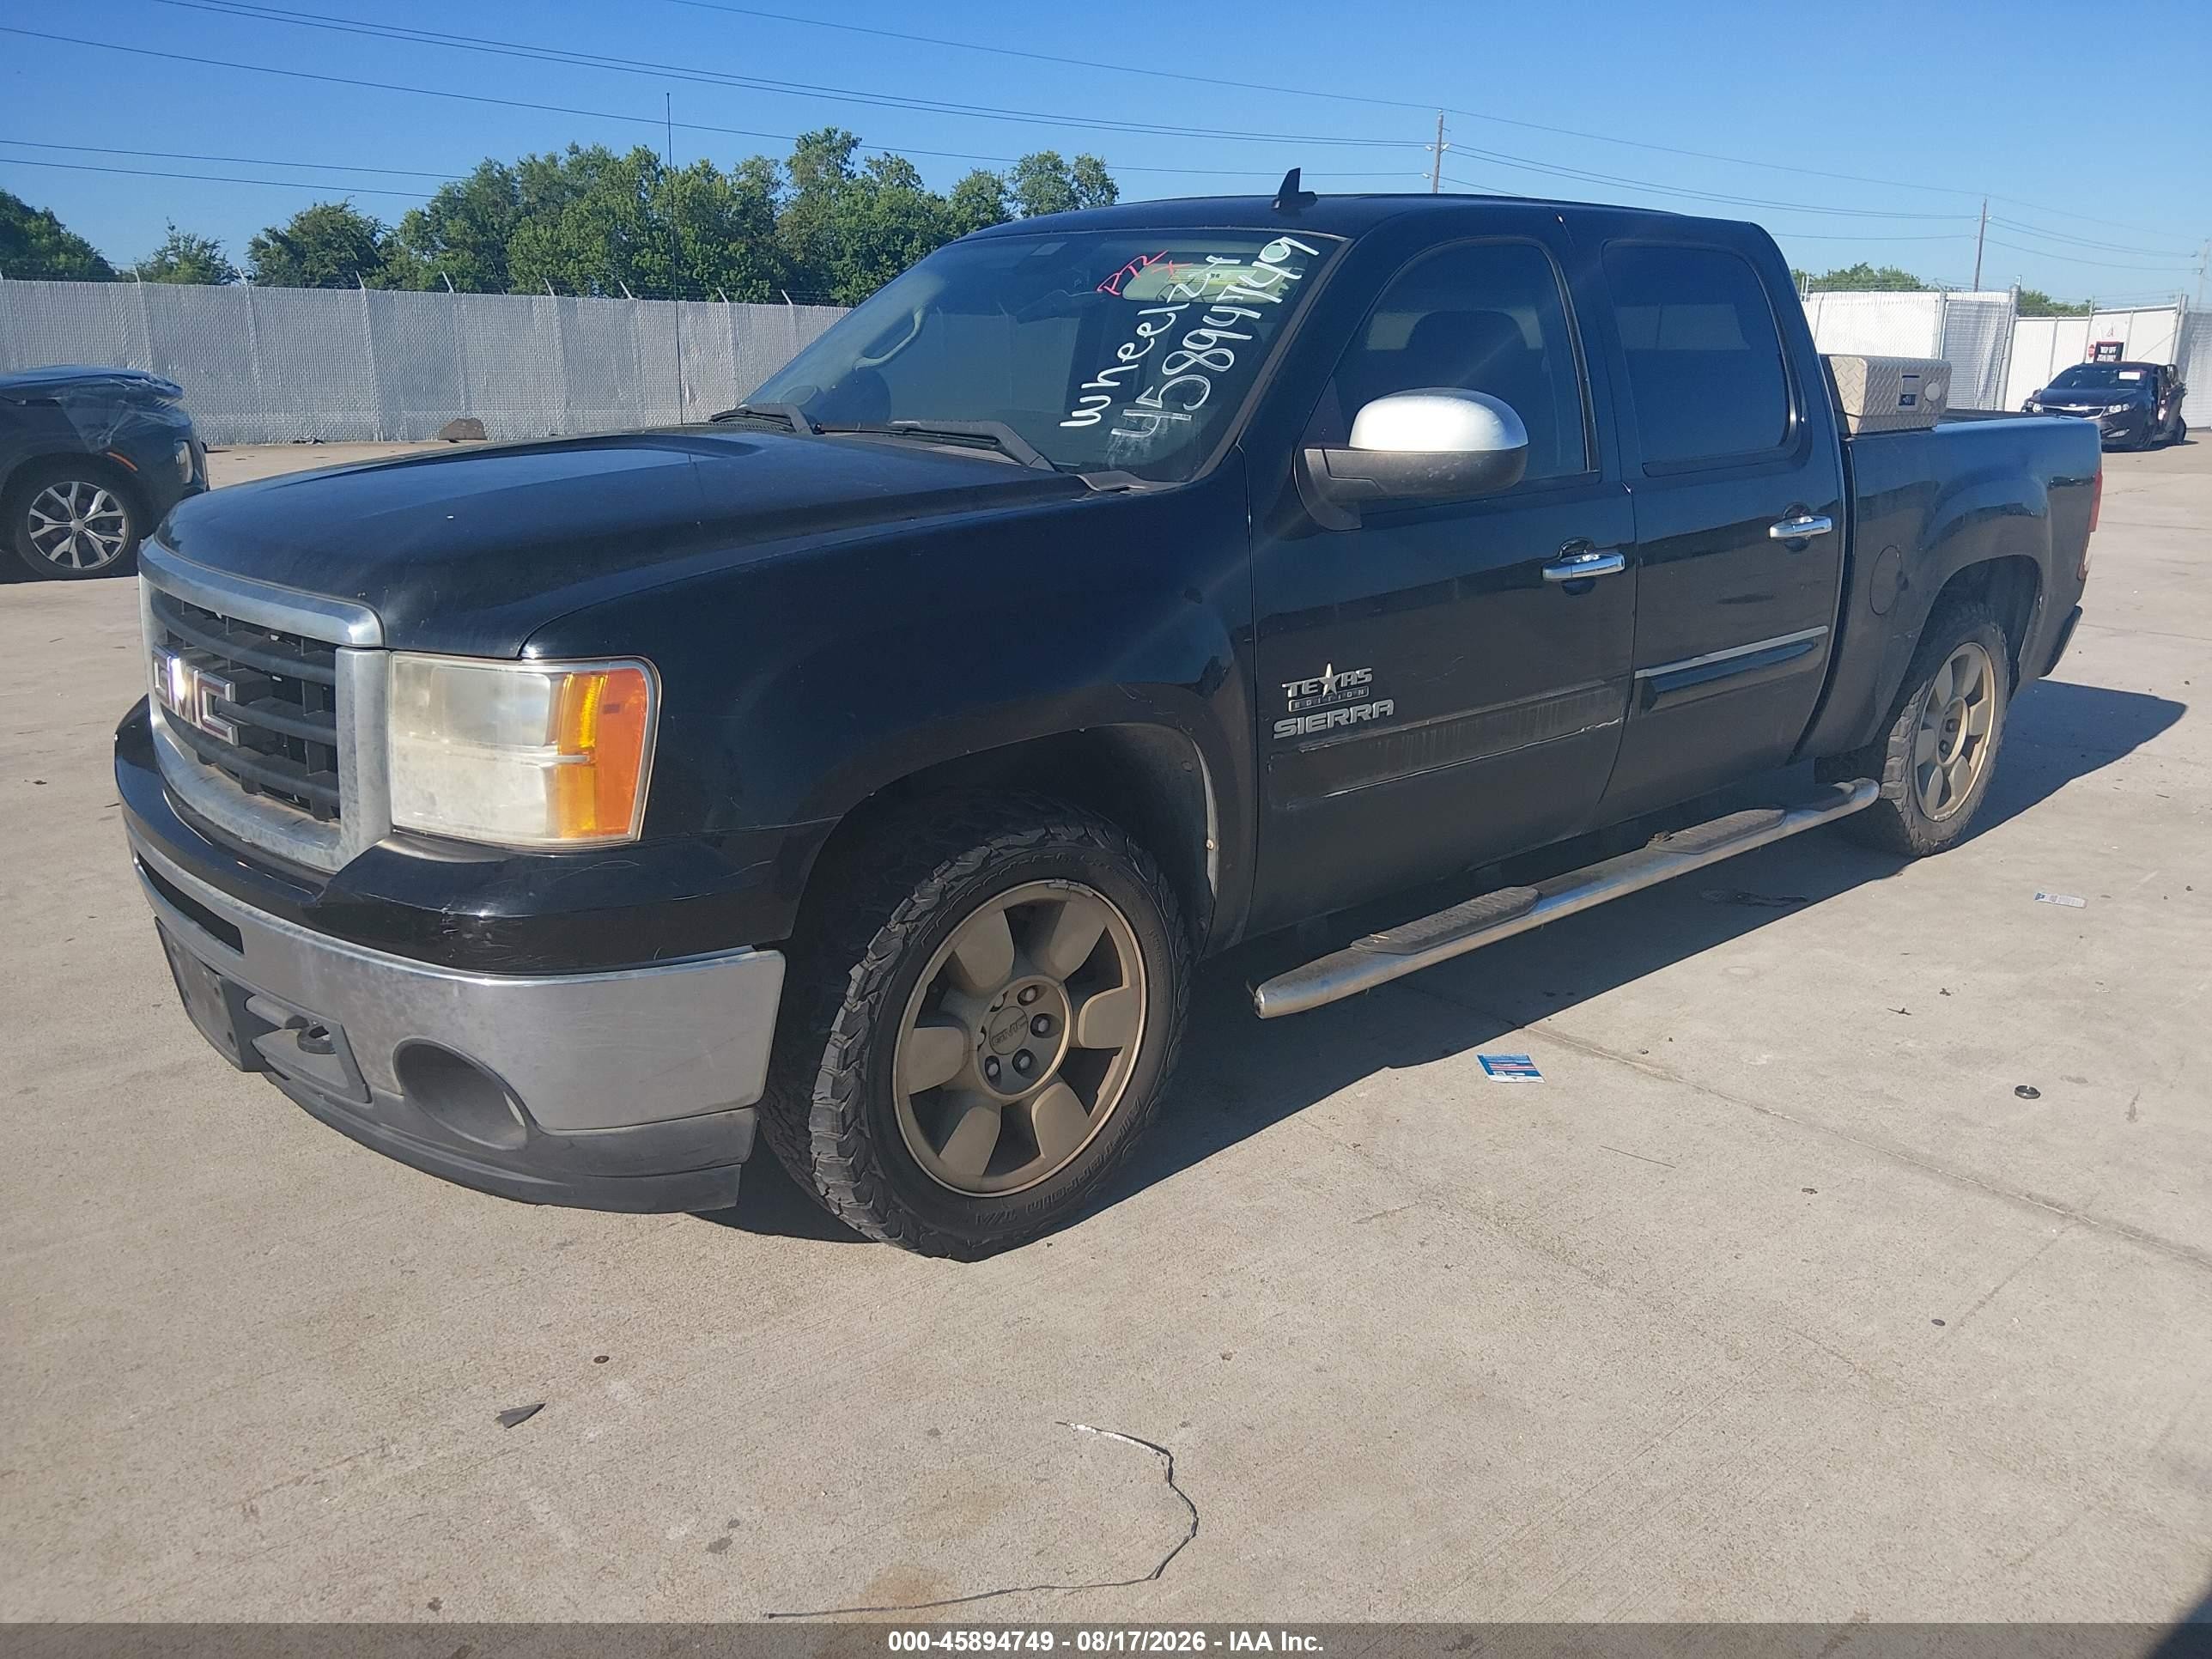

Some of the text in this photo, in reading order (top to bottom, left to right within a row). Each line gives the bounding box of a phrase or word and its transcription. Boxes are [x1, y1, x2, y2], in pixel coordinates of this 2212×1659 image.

[1110, 236, 1320, 439] 45894749
[1281, 663, 1373, 698] TEXAS
[1294, 689, 1365, 709] EDITION
[1273, 699, 1395, 739] SIERRA
